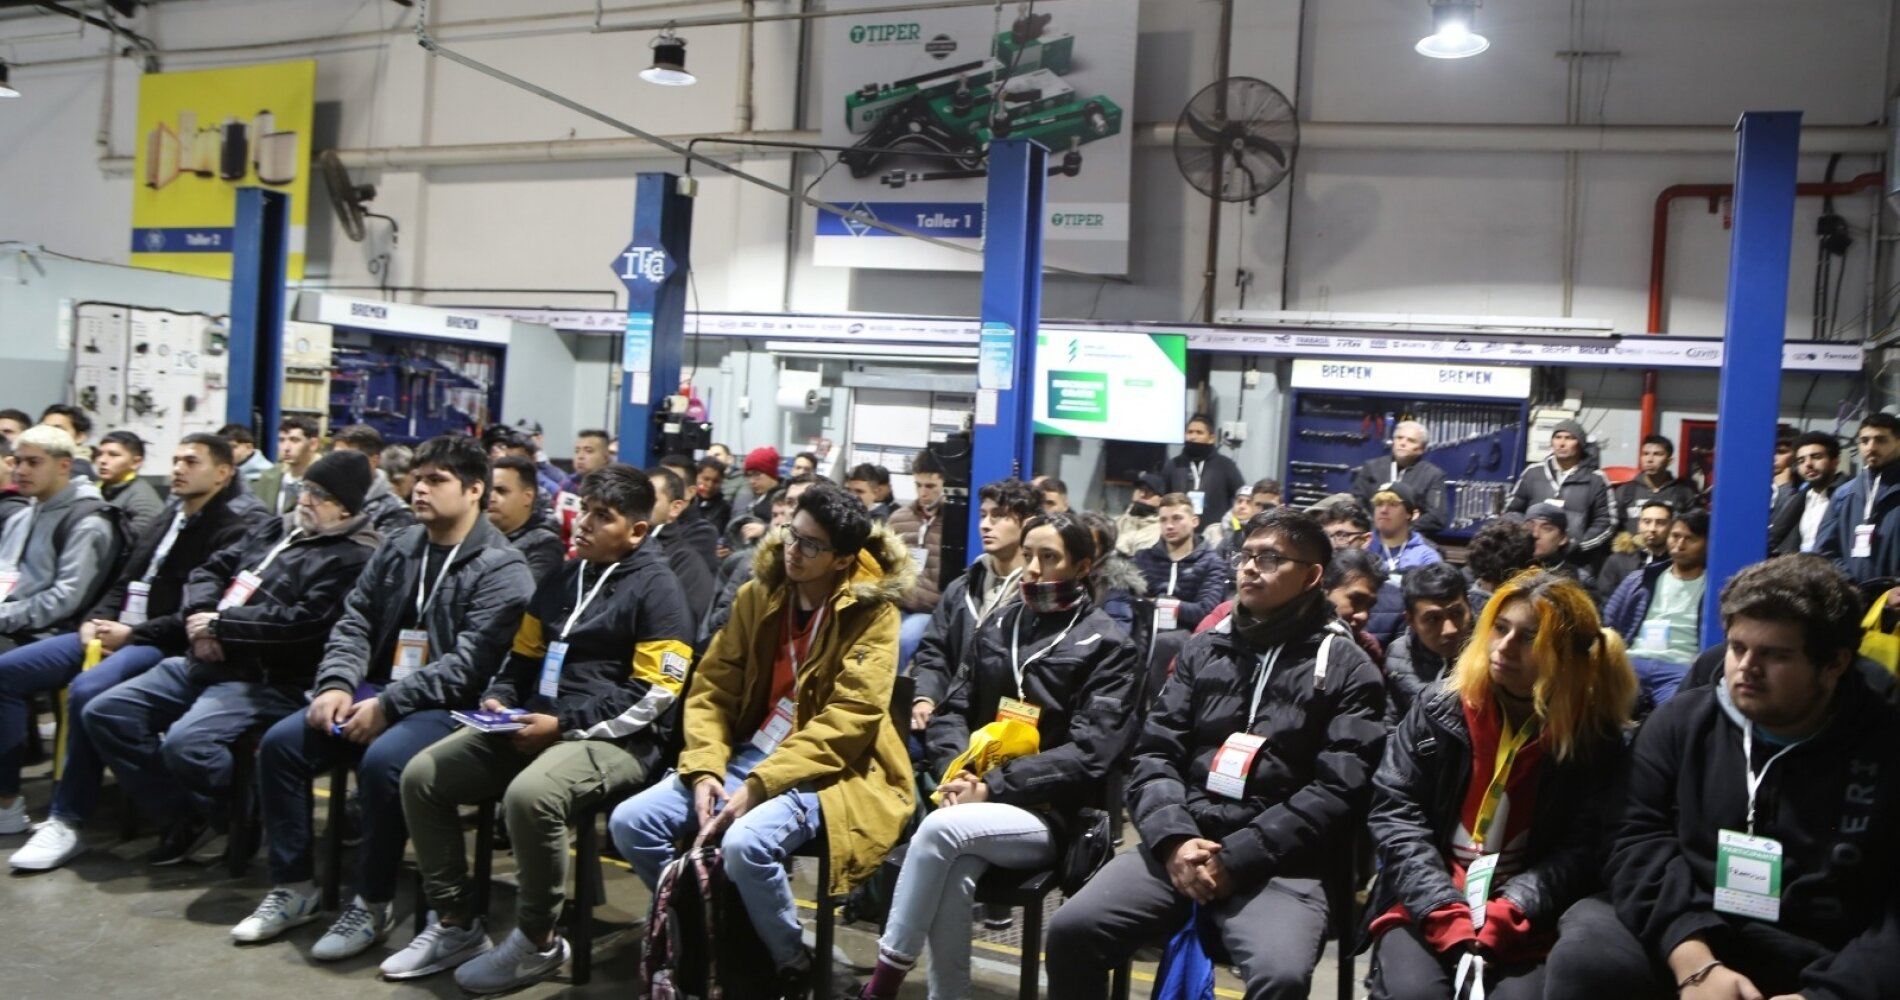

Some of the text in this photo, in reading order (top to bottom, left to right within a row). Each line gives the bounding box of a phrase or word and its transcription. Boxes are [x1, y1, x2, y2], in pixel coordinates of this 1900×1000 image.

[866, 23, 921, 42] TIPER
[916, 213, 972, 228] Taller 1
[1064, 214, 1104, 226] TIPER
[351, 303, 388, 319] BREMEN
[446, 315, 479, 330] BREMEN
[1322, 365, 1373, 379] BREMEN
[1439, 369, 1493, 384] BREMEN
